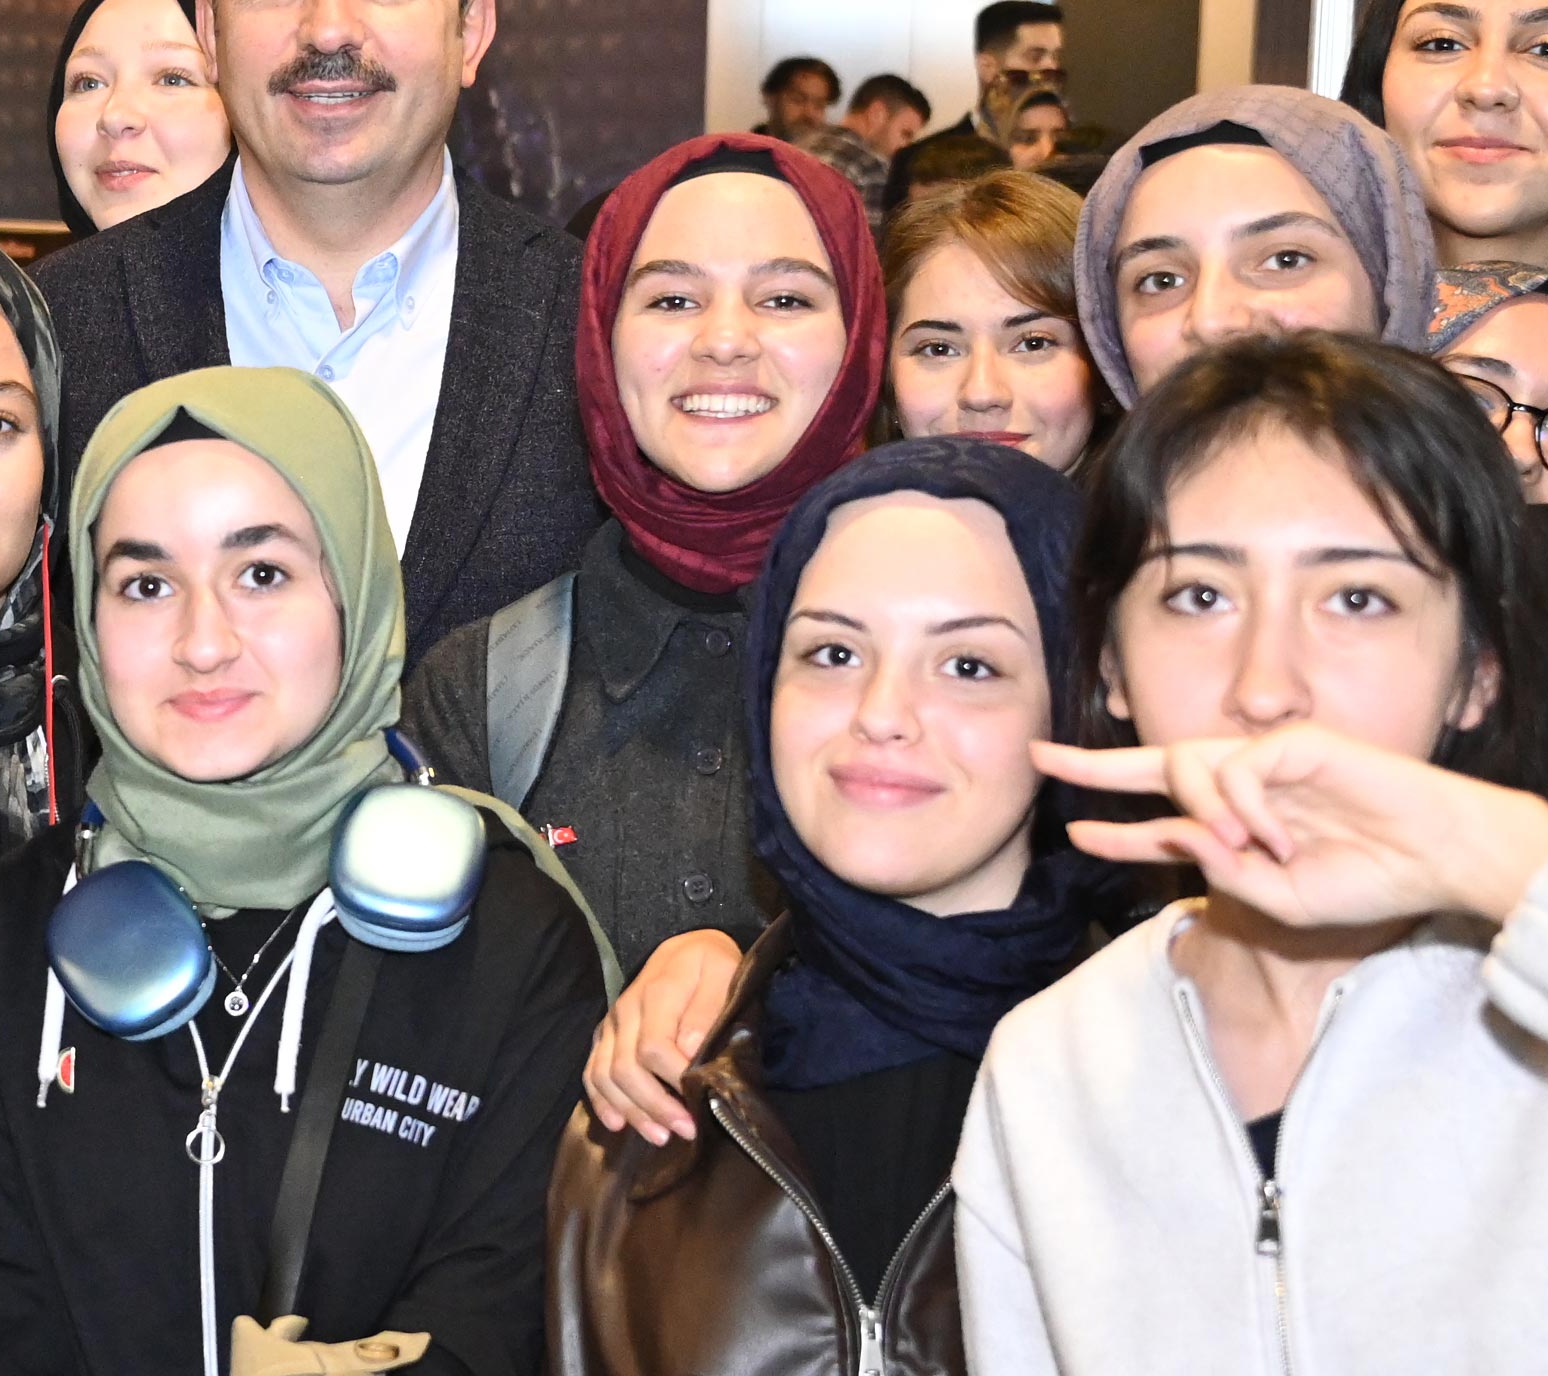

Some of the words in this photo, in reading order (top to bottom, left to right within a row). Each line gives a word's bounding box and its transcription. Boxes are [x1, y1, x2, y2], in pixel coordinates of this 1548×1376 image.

[370, 1062, 428, 1106] WILD
[341, 1097, 399, 1135] URBAN
[398, 1115, 437, 1148] CITY
